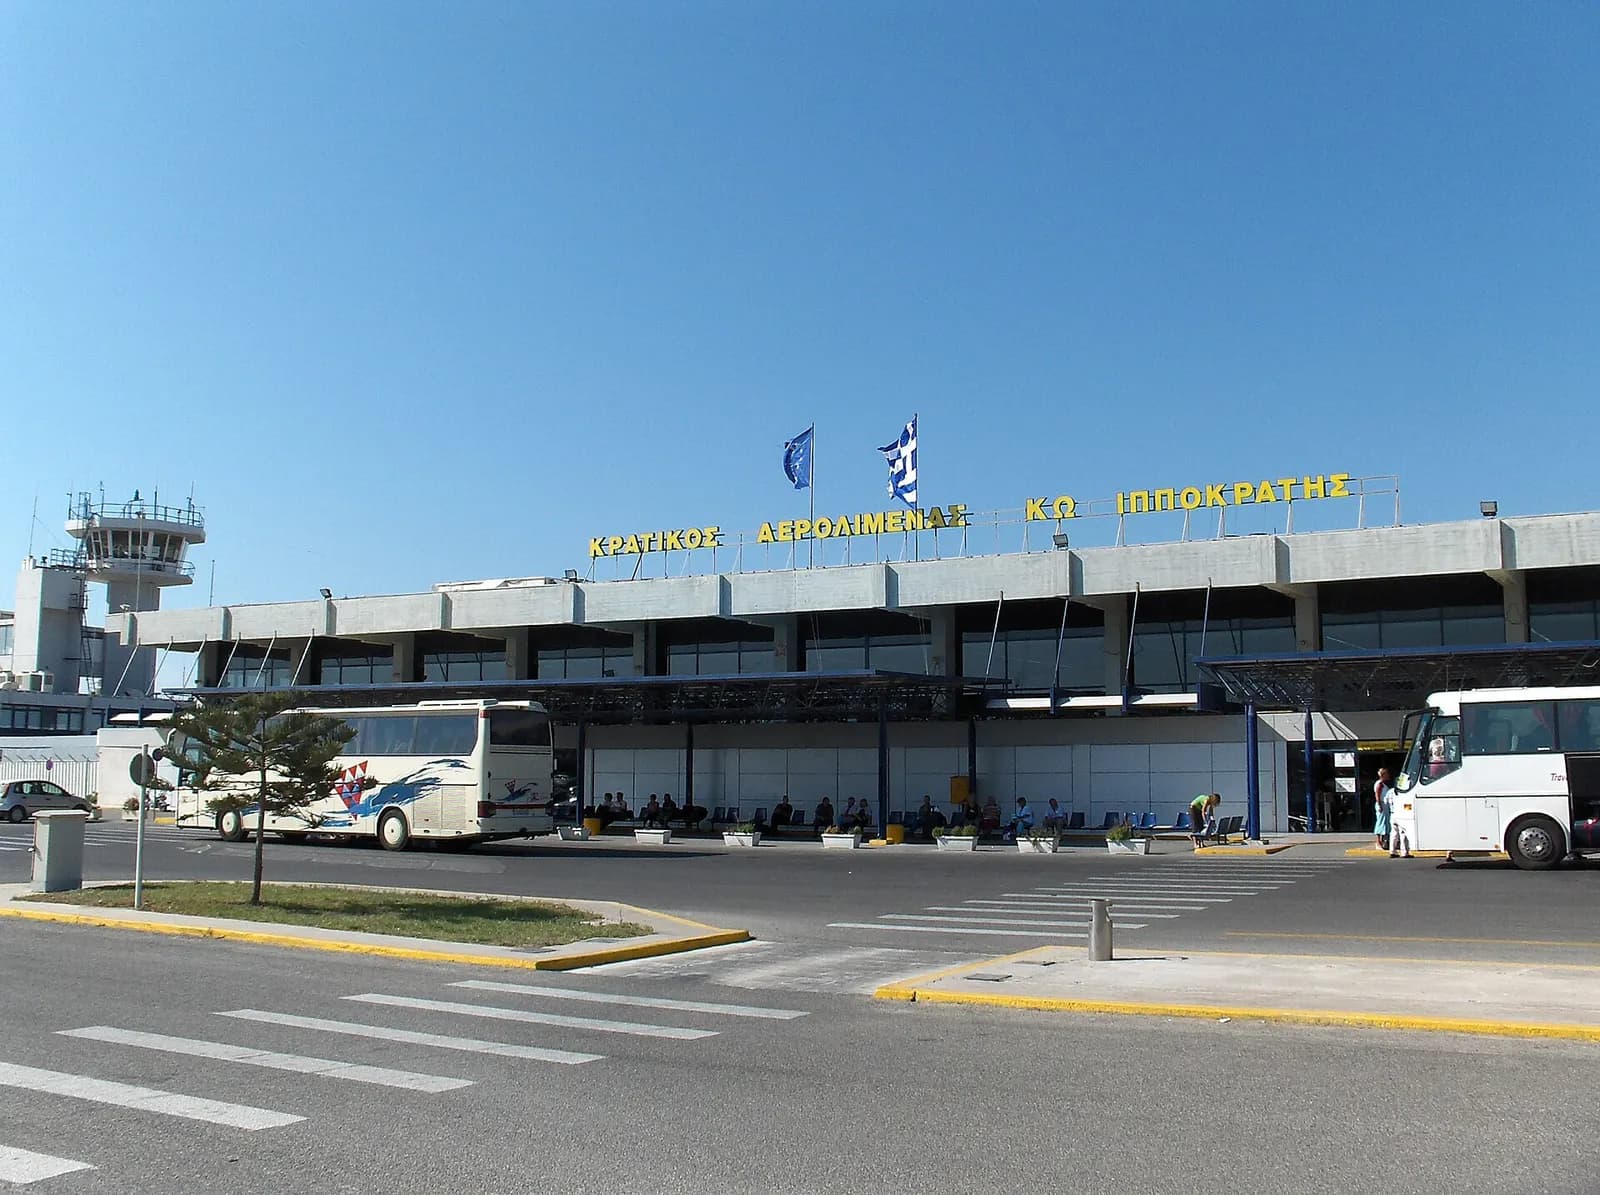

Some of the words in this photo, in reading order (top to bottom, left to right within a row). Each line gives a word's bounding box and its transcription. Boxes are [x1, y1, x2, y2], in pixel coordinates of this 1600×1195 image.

[588, 526, 720, 557] ΚΡΑΤΙΚΟΣ
[756, 504, 967, 543] ΑΕΡΟΛΙΜΕΝΑΣ
[1026, 496, 1076, 520] ΚΩ
[1116, 472, 1350, 514] ΙΠΠΟΚΡΑΤΗΣ
